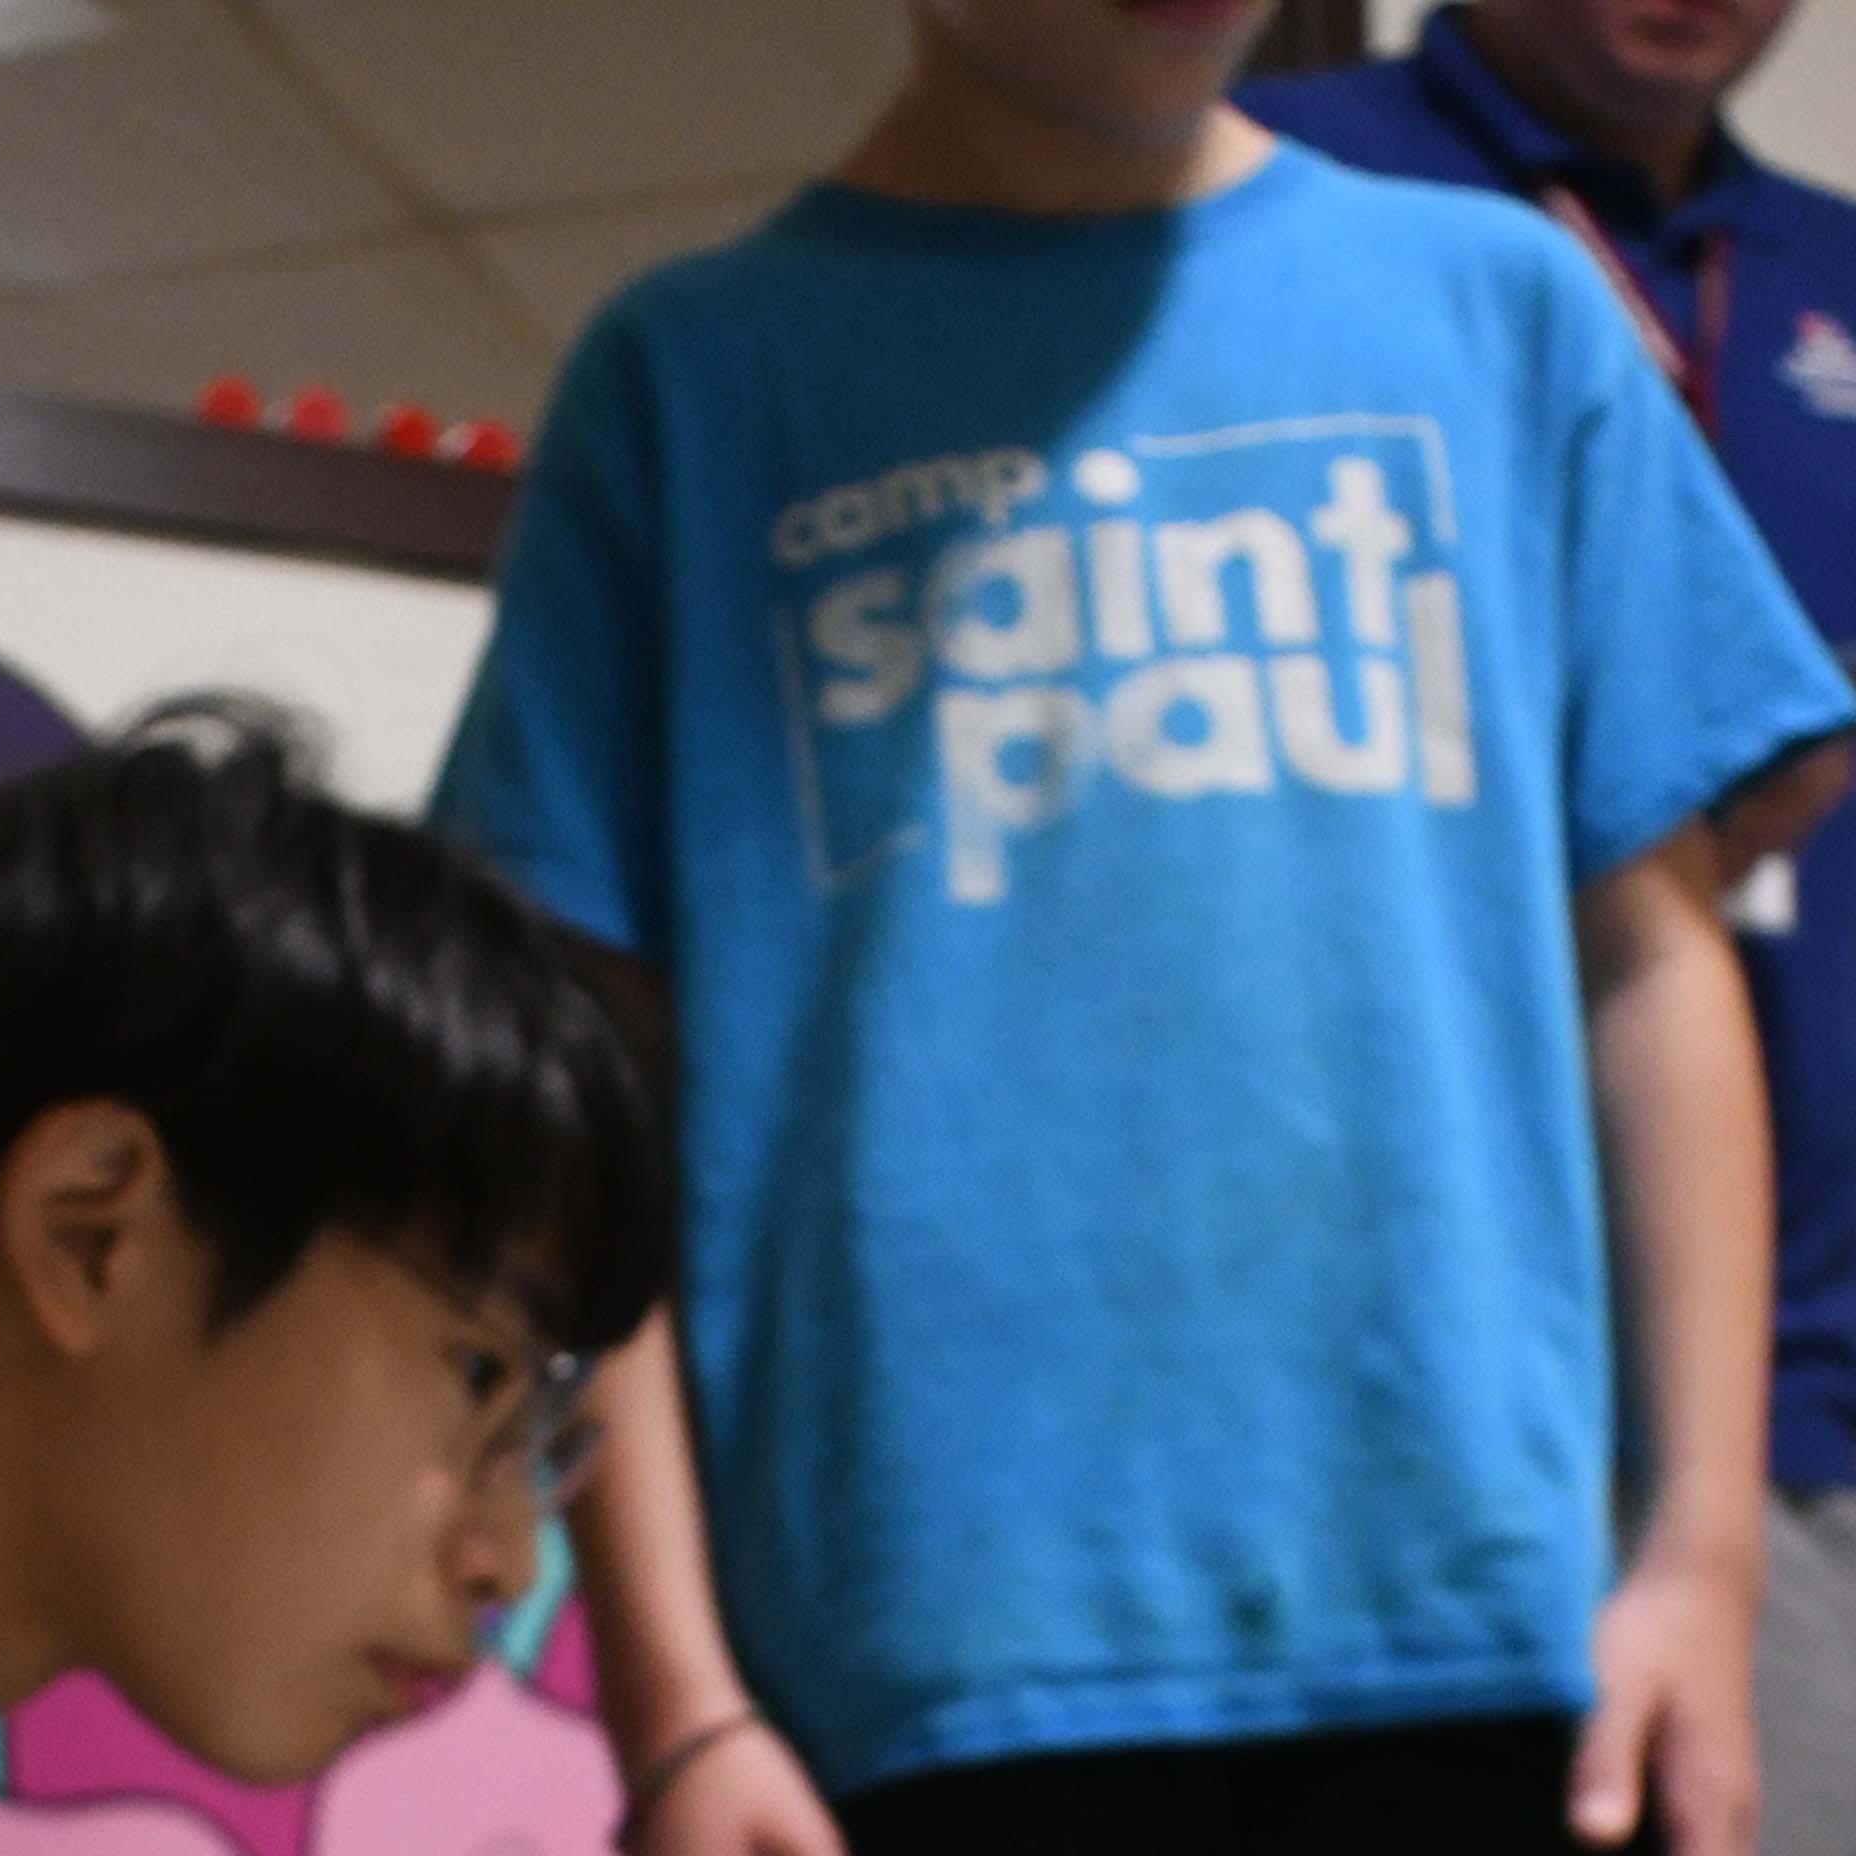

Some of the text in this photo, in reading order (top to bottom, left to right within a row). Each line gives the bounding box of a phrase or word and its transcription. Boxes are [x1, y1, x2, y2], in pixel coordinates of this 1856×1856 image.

[771, 446, 1049, 566] camp
[811, 447, 1412, 725] saint
[940, 572, 1476, 905] paul
